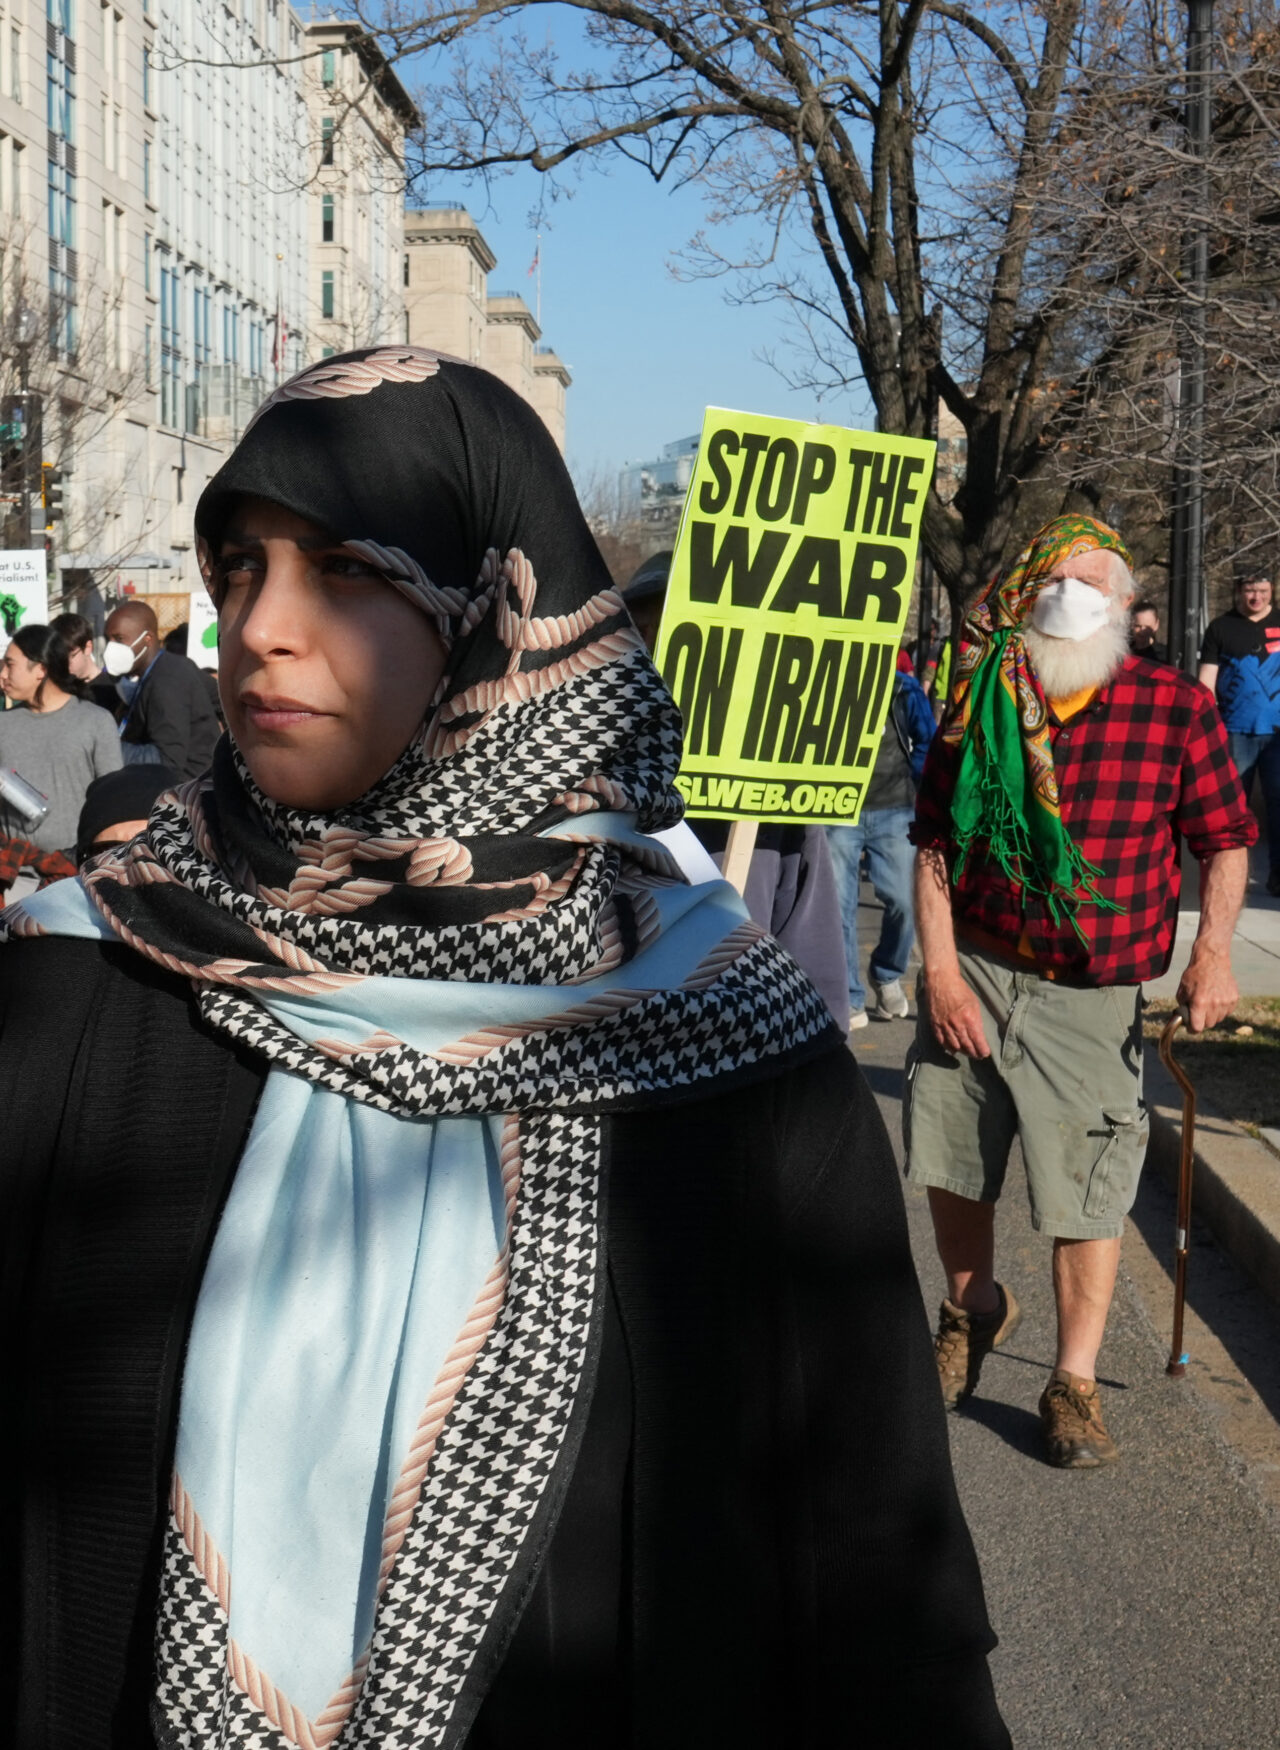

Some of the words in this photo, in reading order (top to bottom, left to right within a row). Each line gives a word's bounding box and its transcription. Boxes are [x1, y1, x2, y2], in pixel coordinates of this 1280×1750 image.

[699, 429, 837, 527] STOP
[843, 448, 925, 539] THE
[13, 562, 36, 571] U.S.
[689, 520, 907, 624] WAR
[663, 621, 745, 757] ON
[740, 632, 895, 768] IRAN!
[672, 775, 860, 815] SLWEB.ORG
